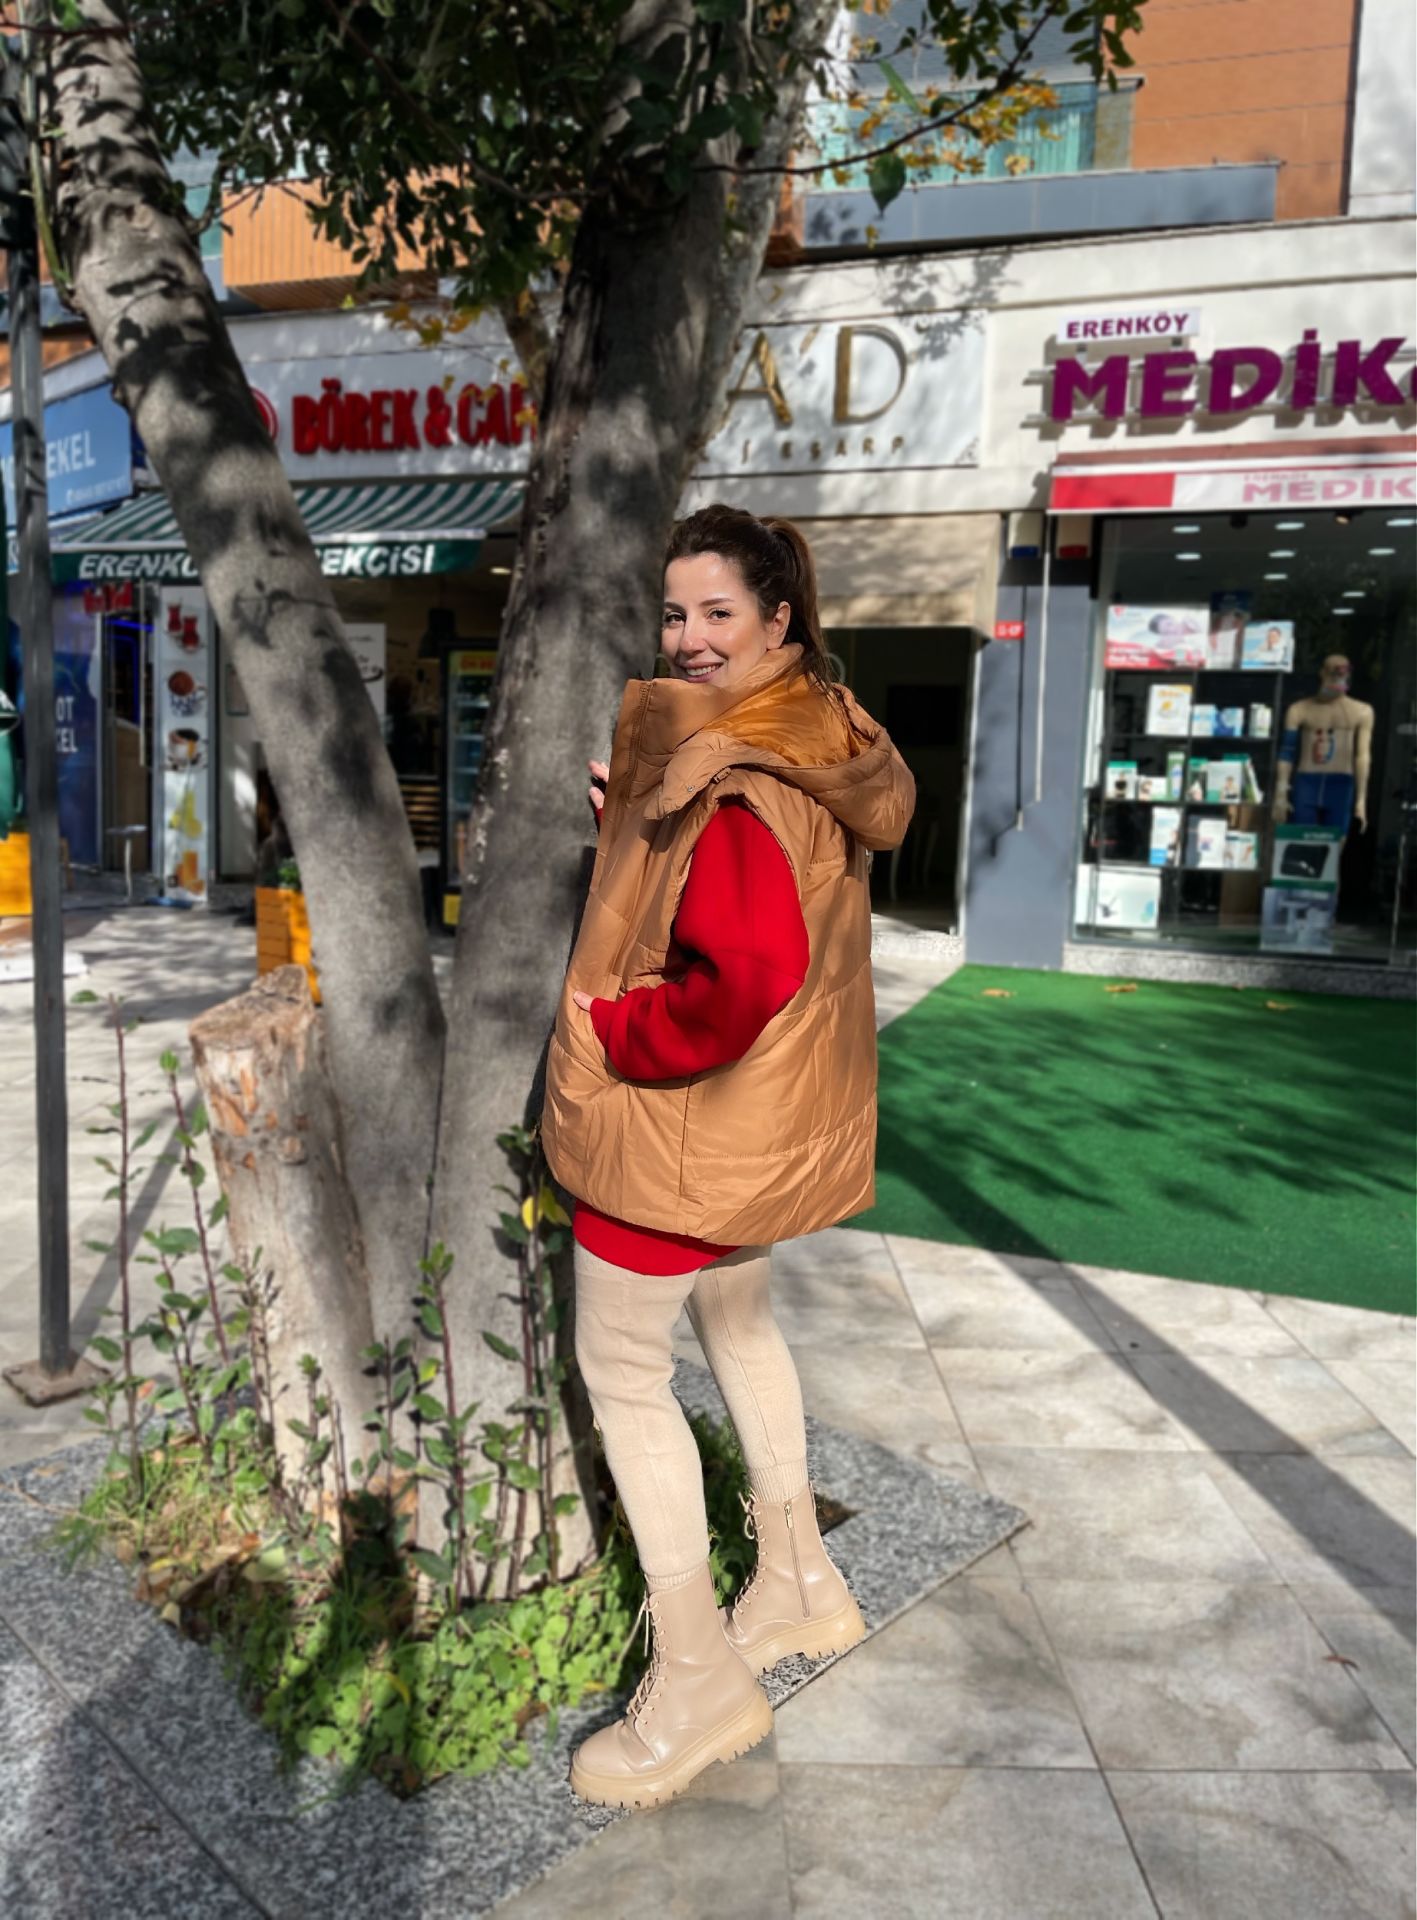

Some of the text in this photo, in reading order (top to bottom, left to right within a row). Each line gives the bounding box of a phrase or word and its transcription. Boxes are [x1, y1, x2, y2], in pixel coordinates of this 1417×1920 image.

[1066, 311, 1190, 340] ERENKÖY
[1050, 328, 1417, 421] MEDİK
[292, 376, 537, 454] BÖREK & CAF
